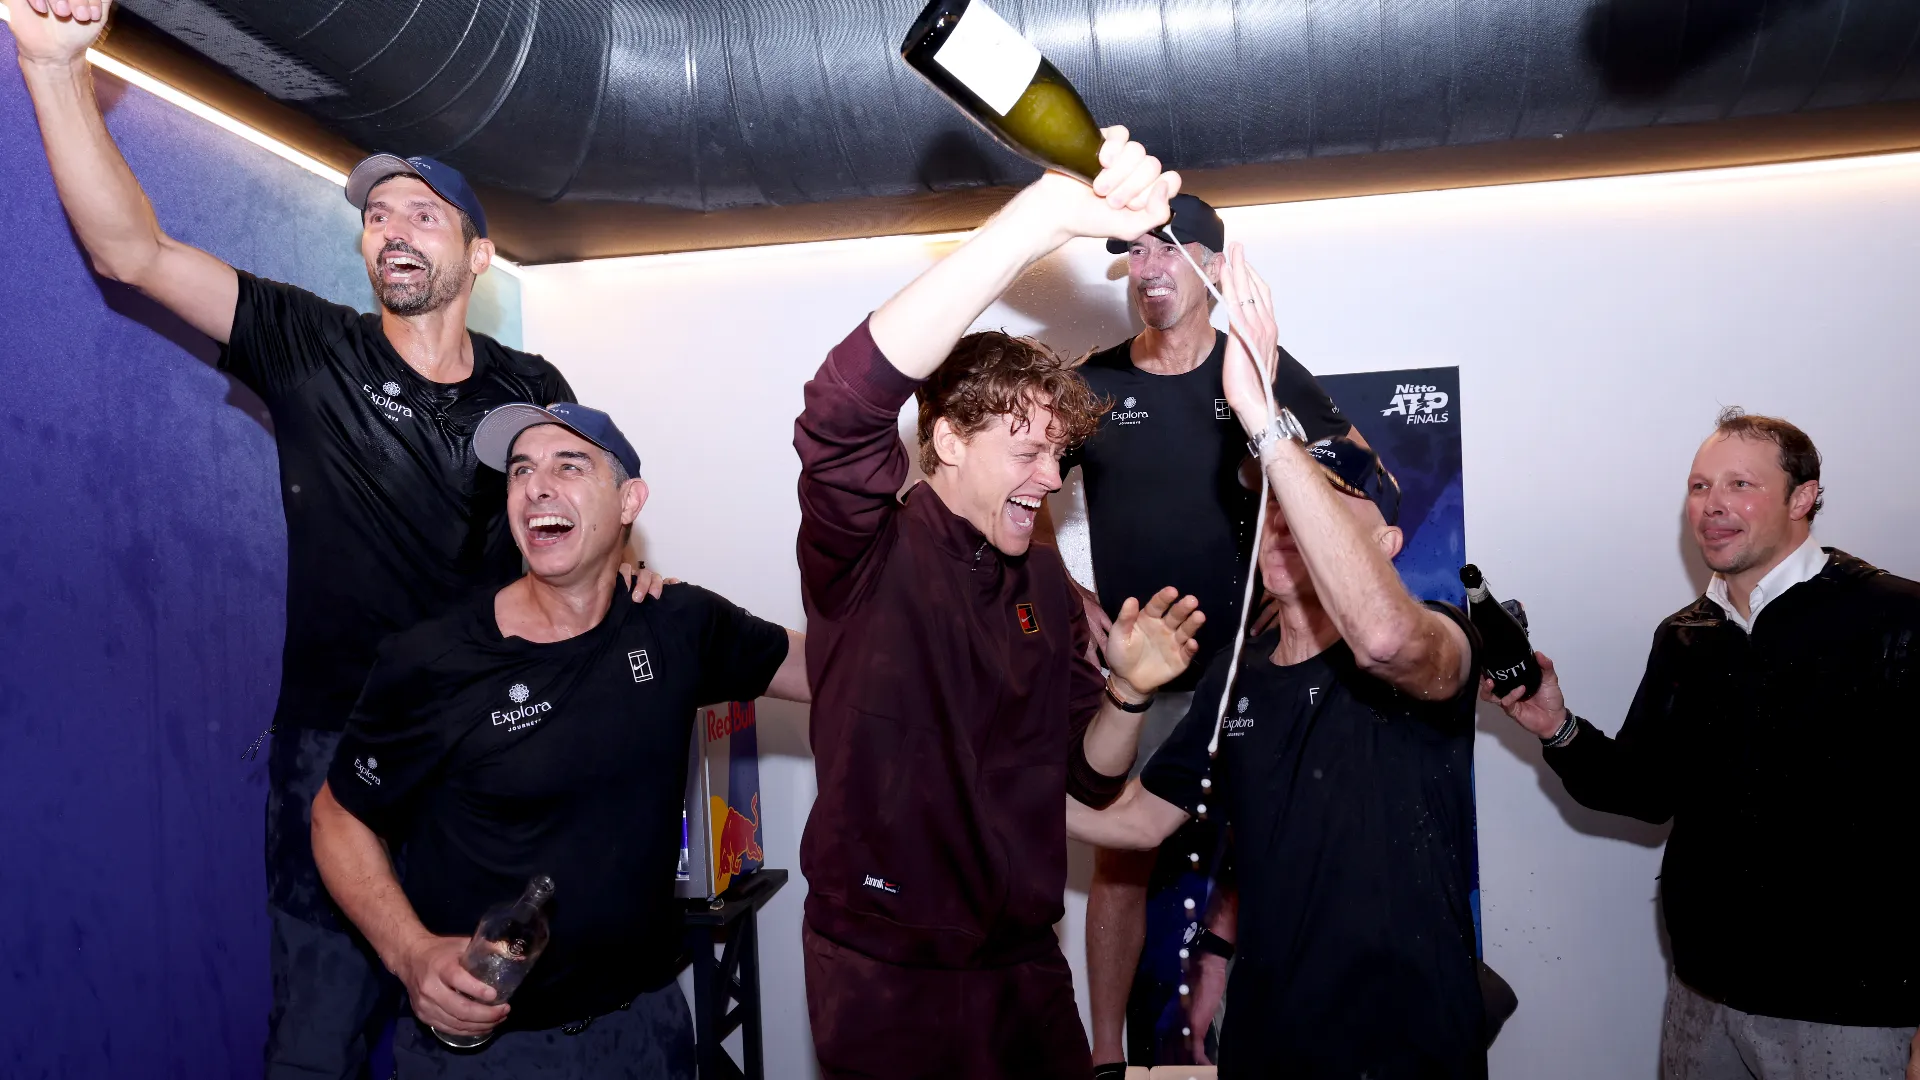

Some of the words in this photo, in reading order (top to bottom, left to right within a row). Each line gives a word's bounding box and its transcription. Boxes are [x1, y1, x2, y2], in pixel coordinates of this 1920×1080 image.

[1395, 384, 1437, 394] Nitto
[1380, 391, 1449, 417] ATP
[1111, 410, 1149, 421] Explora
[1406, 413, 1449, 425] FINALS
[1304, 446, 1336, 459] lora
[491, 701, 552, 726] Explora
[707, 701, 732, 743] Red
[733, 699, 755, 732] Bull
[1222, 716, 1254, 731] Explora
[354, 758, 381, 786] Explora
